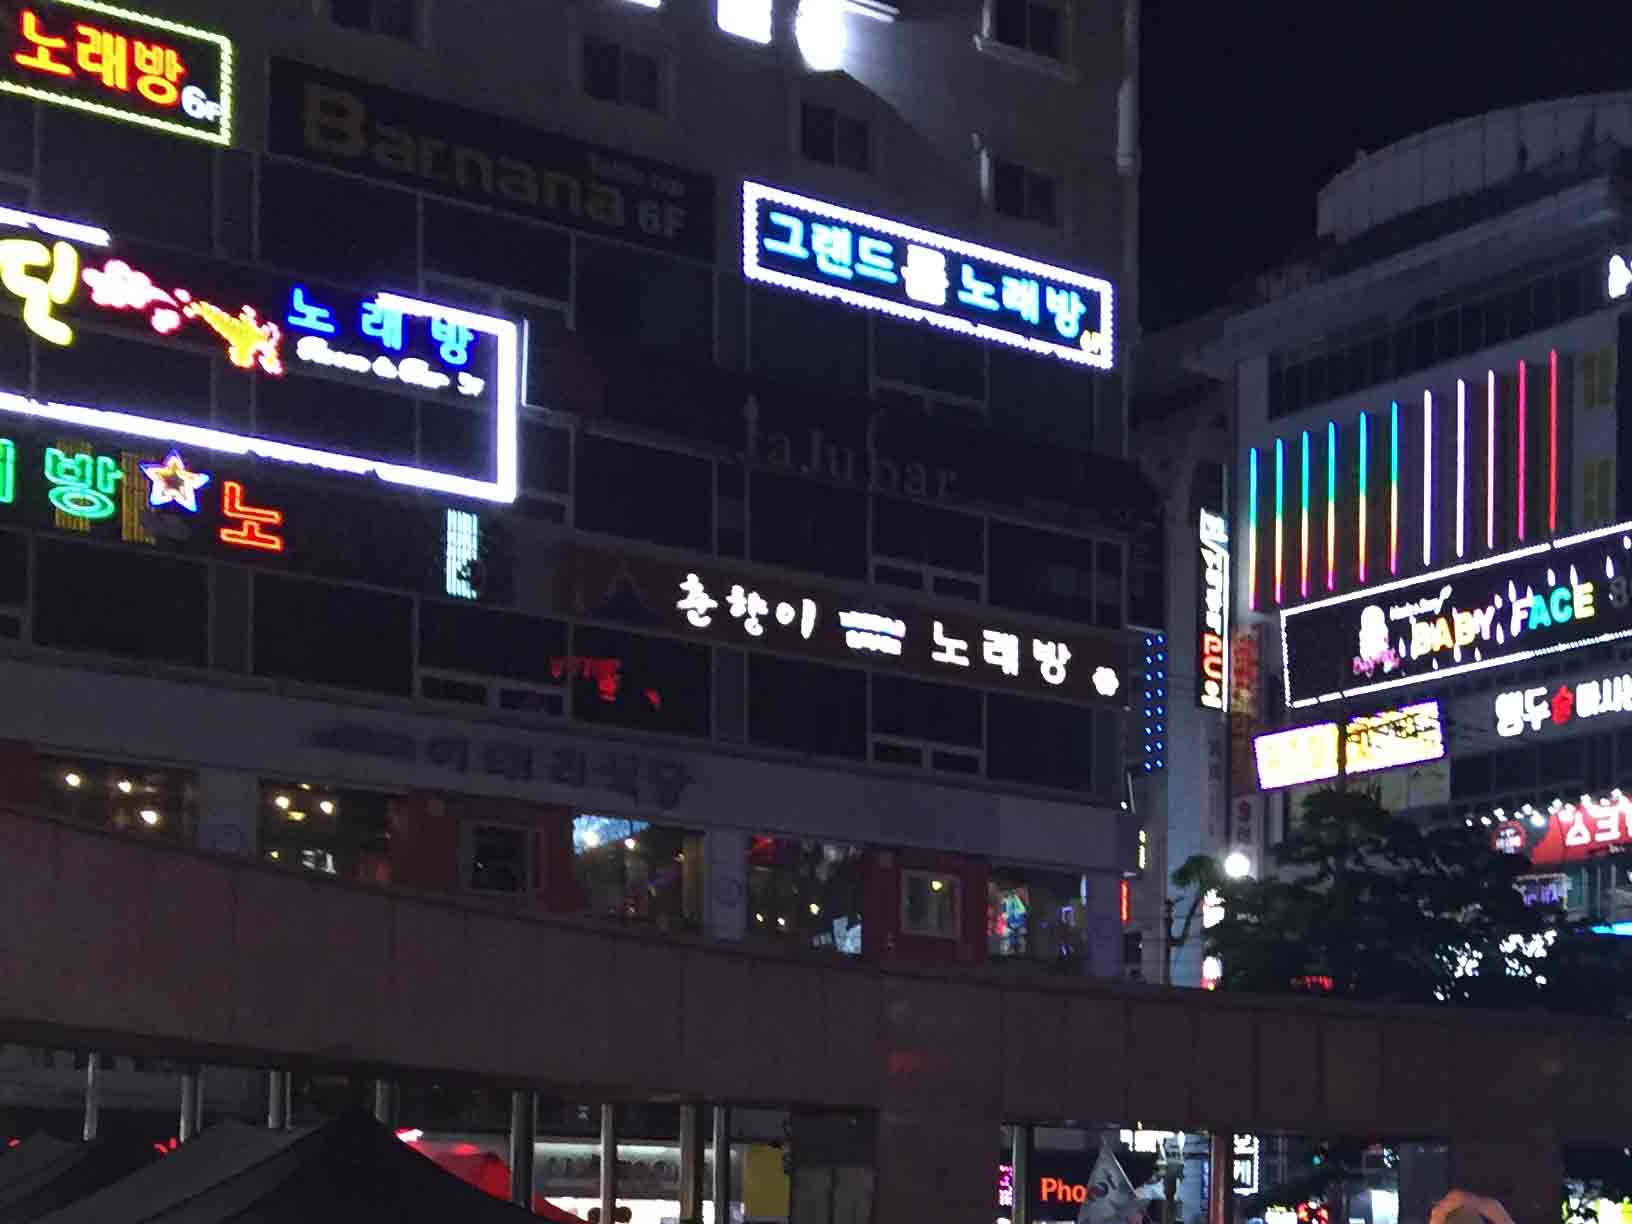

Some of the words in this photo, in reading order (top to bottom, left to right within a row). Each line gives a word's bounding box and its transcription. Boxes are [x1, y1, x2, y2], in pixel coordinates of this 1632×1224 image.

[14, 9, 187, 106] 노래방
[762, 211, 899, 284] 그랜드
[956, 263, 1086, 339] 노래방
[287, 288, 474, 365] 노래방
[677, 573, 817, 638] 춘향이
[931, 621, 1071, 685] 노래방
[1411, 604, 1496, 658] BABY
[1511, 582, 1595, 637] FACE
